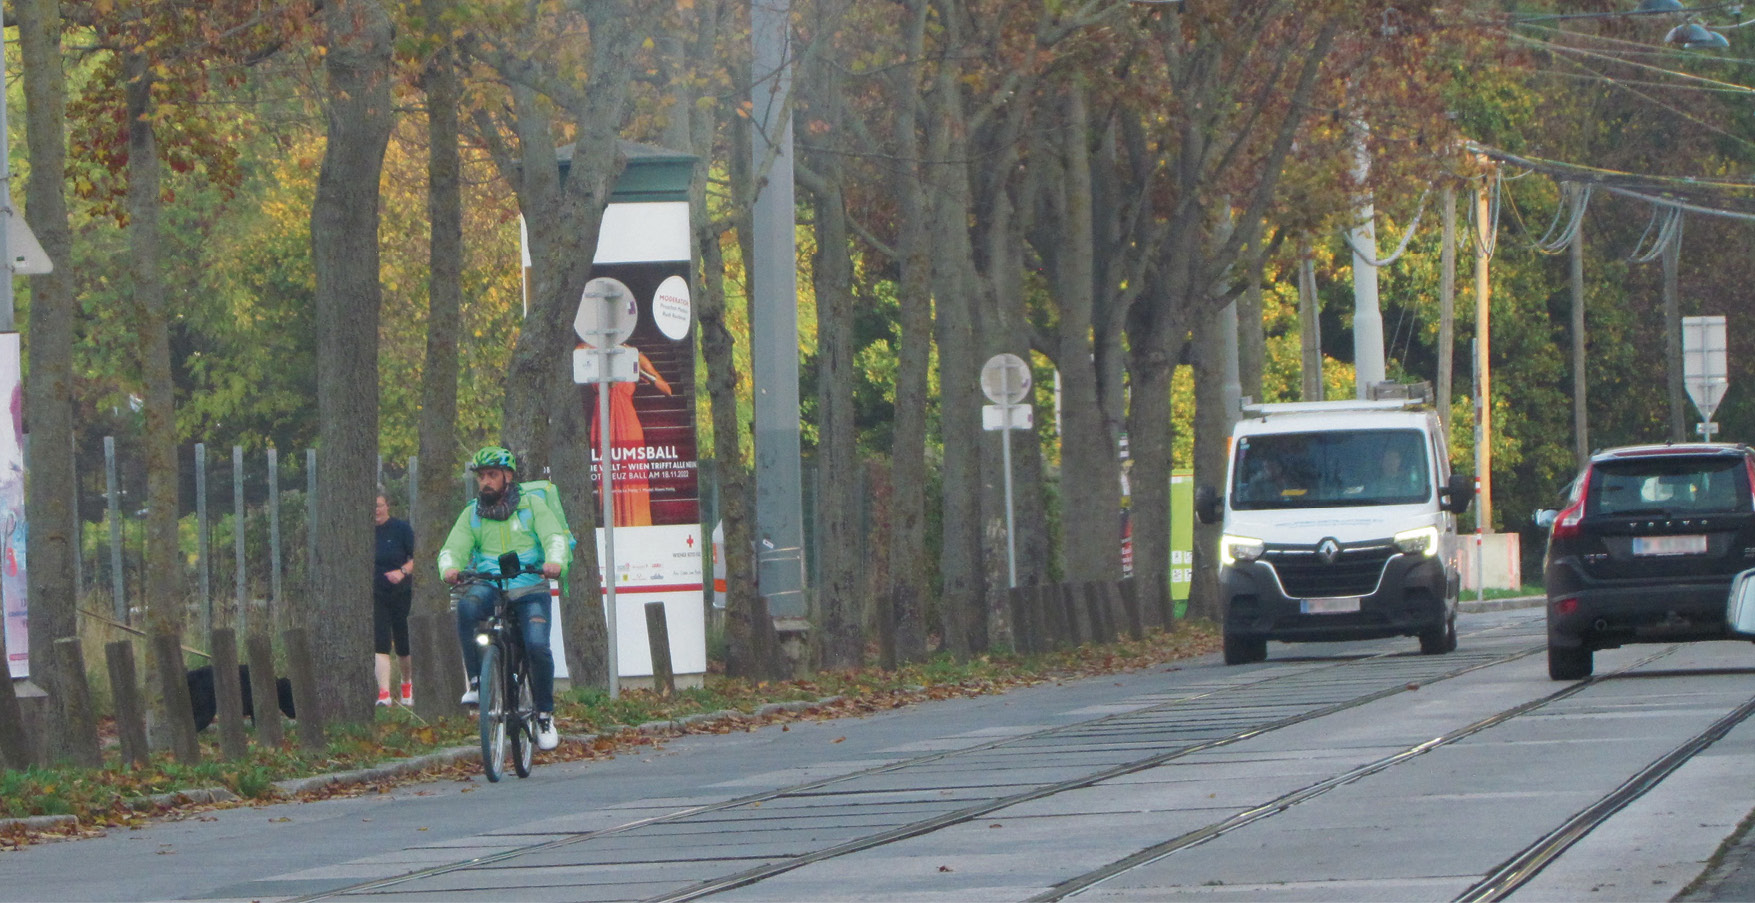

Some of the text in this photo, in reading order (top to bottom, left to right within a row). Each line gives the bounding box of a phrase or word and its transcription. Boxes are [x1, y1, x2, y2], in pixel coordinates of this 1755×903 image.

[591, 445, 678, 461] LUMSBALL
[651, 462, 672, 470] TRIFFT
[648, 471, 660, 479] AM
[1630, 519, 1708, 528] VOLVO
